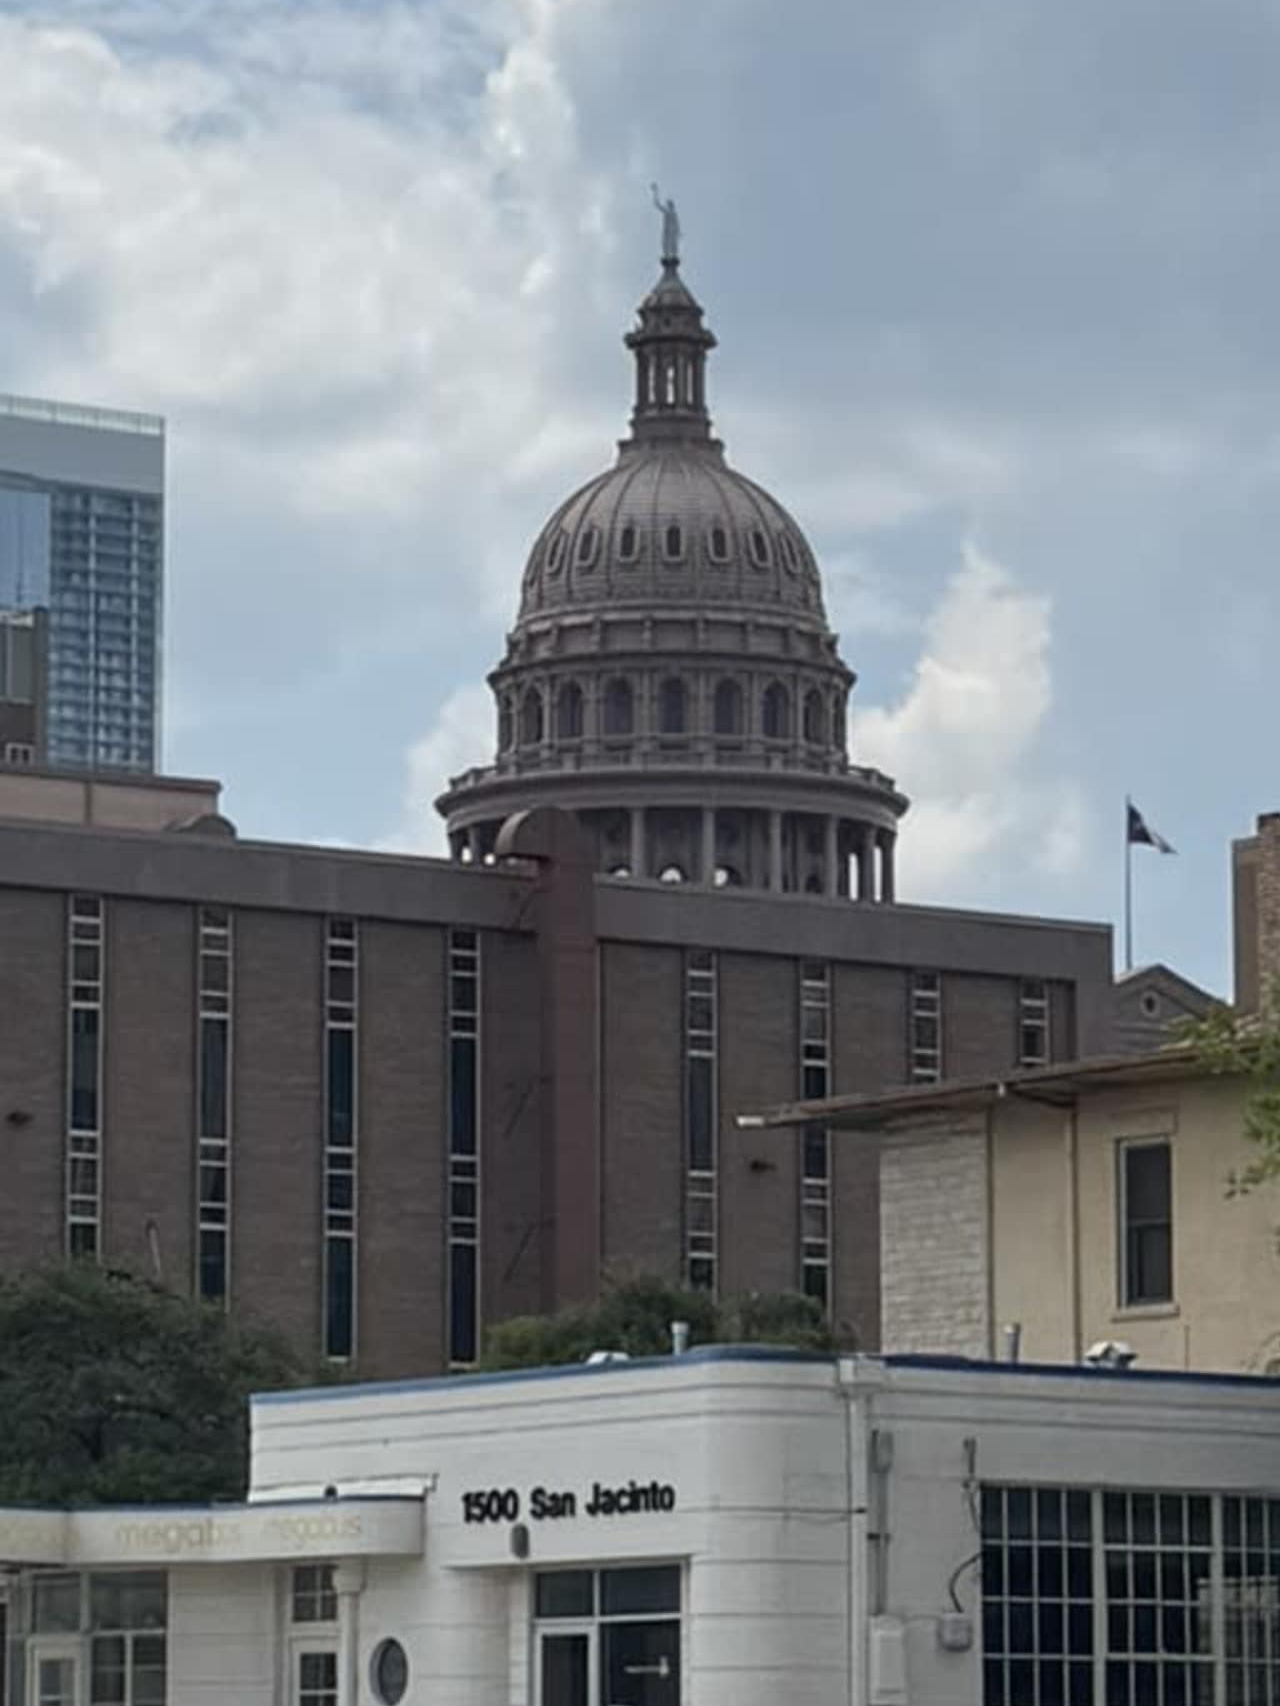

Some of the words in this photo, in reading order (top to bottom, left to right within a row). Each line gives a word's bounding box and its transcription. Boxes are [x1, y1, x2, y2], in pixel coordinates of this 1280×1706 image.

[462, 1488, 519, 1523] 1500
[530, 1486, 576, 1520] San
[586, 1479, 675, 1516] Jacinto
